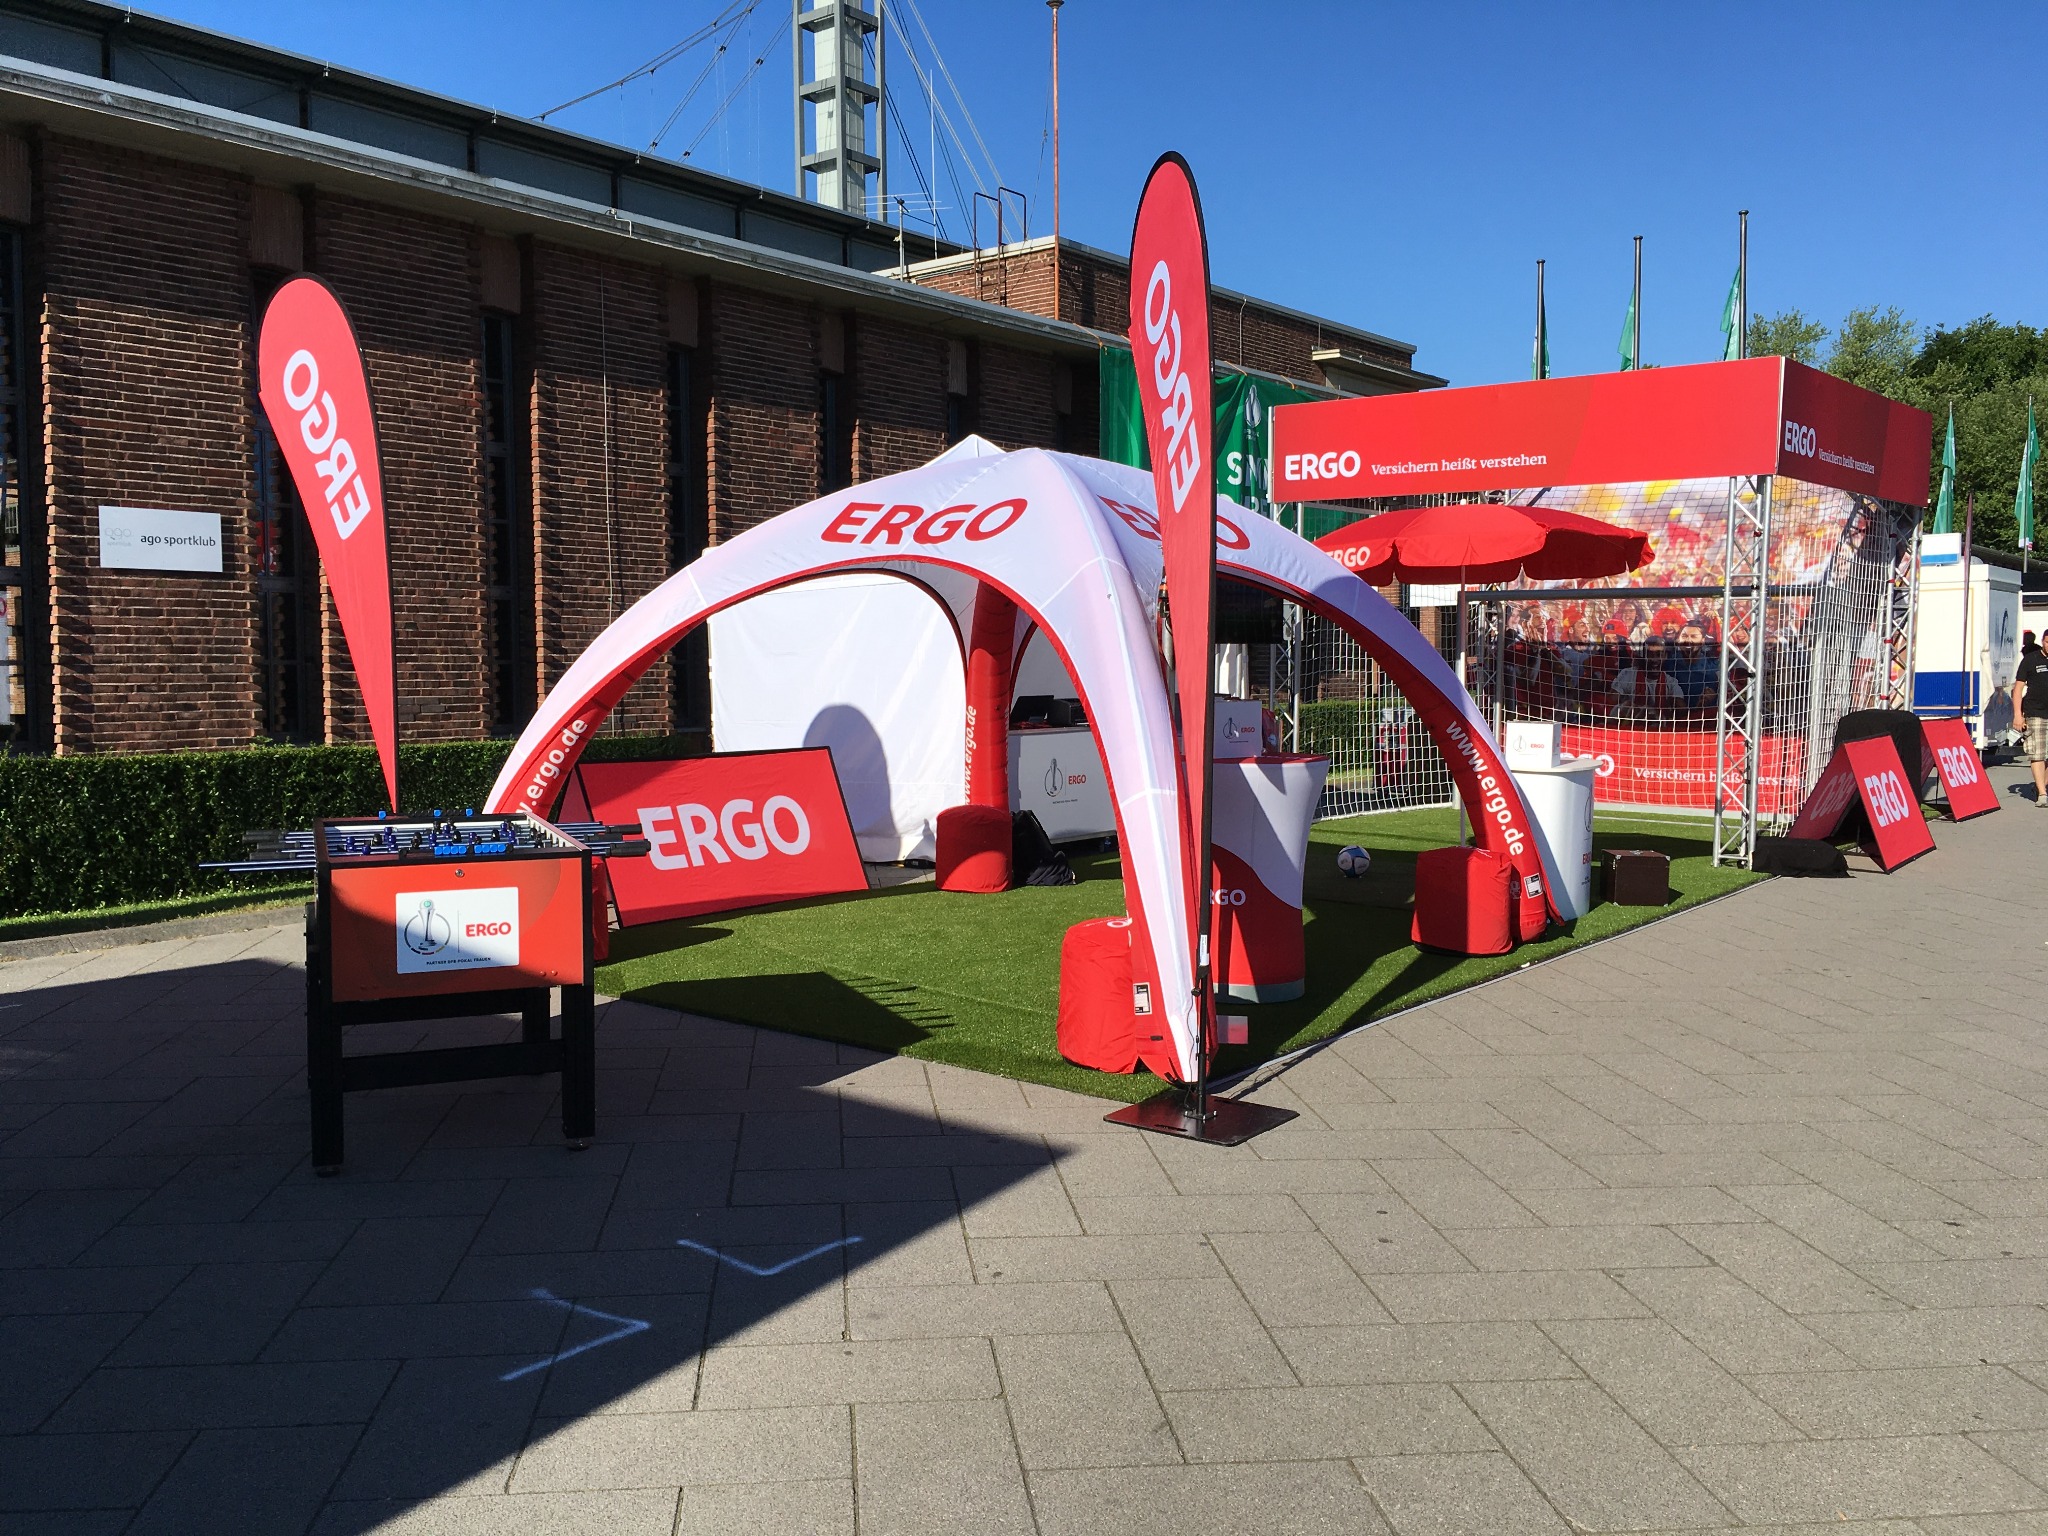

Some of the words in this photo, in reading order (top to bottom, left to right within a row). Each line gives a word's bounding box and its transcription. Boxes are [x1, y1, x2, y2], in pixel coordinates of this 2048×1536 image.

[1145, 260, 1201, 514] ERGO
[283, 349, 371, 541] ERGO
[1784, 420, 1817, 458] ERGO
[1284, 450, 1361, 481] ERGO
[1371, 461, 1439, 476] Versichern
[1441, 457, 1477, 471] heißt
[1480, 454, 1548, 469] verstehen
[140, 535, 162, 546] ago
[164, 535, 216, 547] sportklub
[820, 498, 1028, 545] ERGO
[1068, 774, 1087, 785] ERGO
[1635, 767, 1706, 783] Versichern
[1937, 745, 1978, 788] ERGO
[1446, 721, 1524, 856] www.ergo.de
[1864, 769, 1909, 828] ERGO
[636, 795, 811, 871] ERGO
[465, 921, 512, 938] ERGO
